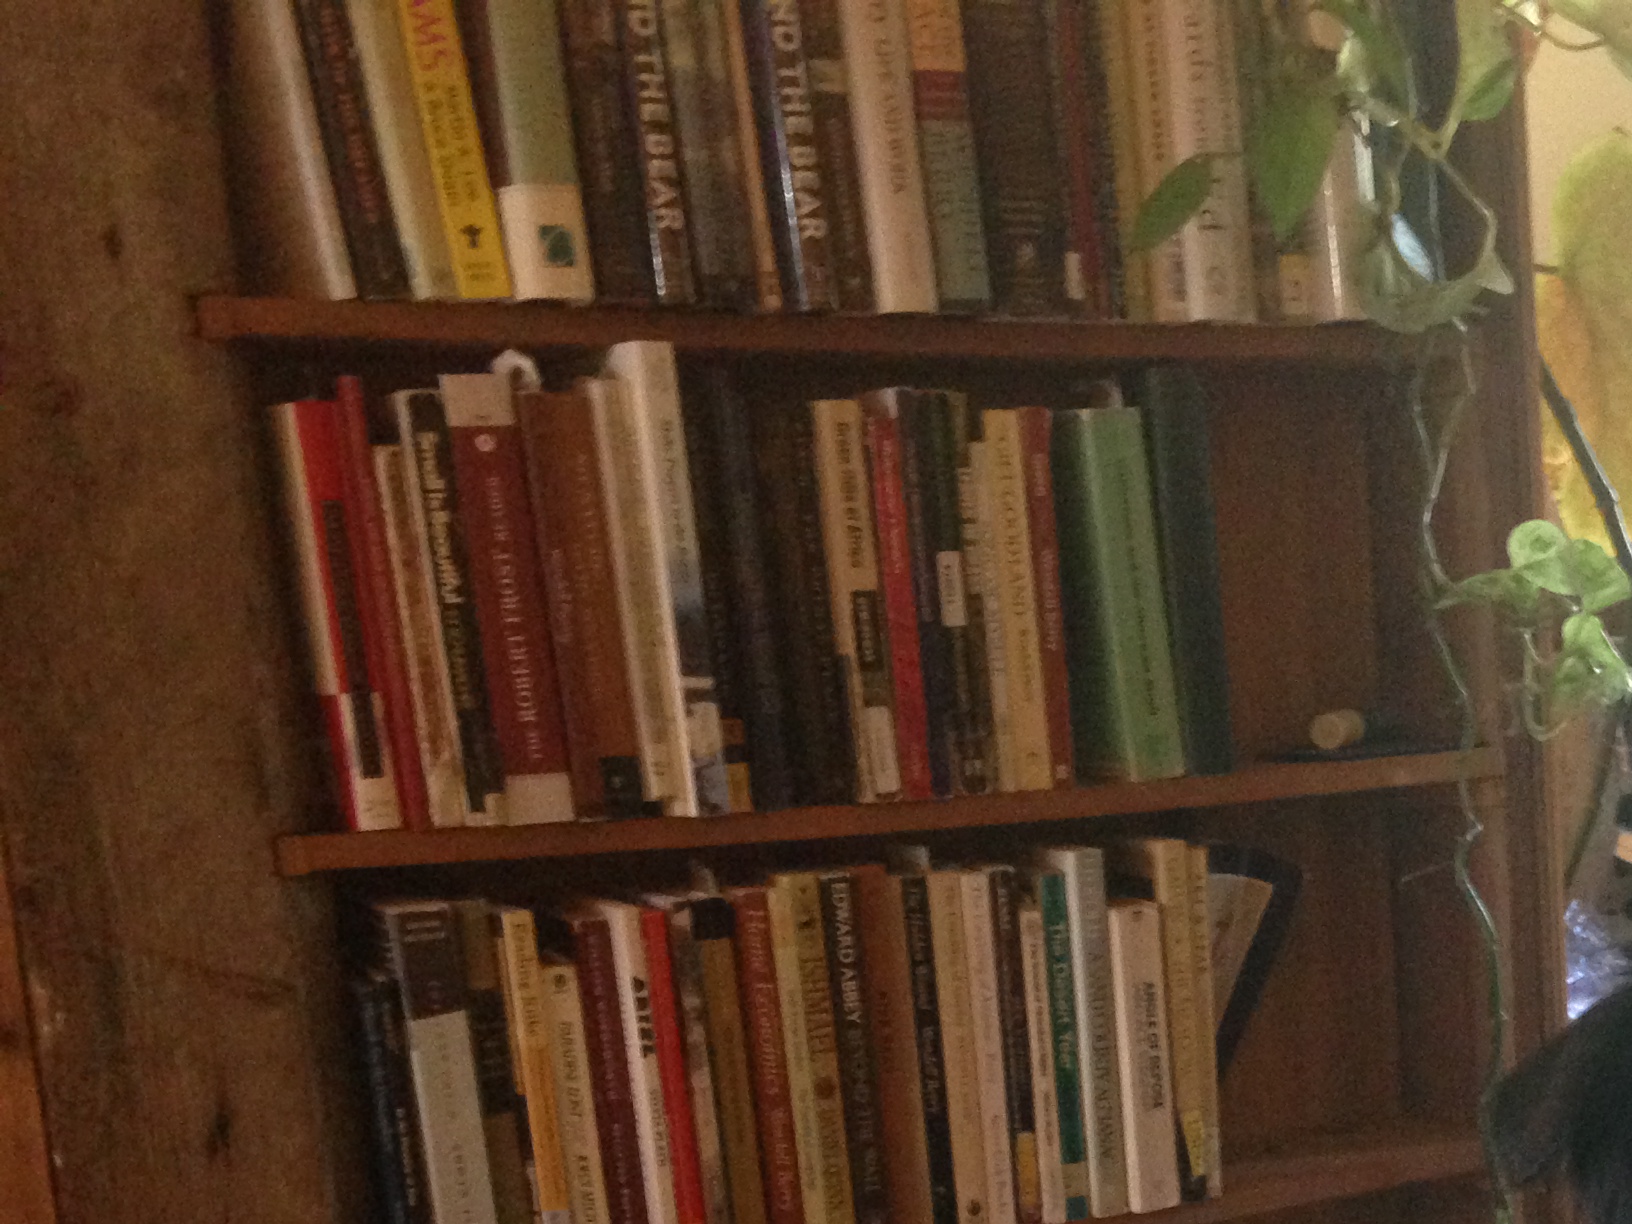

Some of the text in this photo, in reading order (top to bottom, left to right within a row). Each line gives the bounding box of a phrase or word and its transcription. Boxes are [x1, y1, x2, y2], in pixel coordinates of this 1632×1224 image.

[632, 50, 671, 125] THE
[776, 60, 813, 137] THE
[643, 129, 686, 233] BEAR
[787, 142, 827, 241] BEAR
[414, 428, 446, 491] Small
[426, 507, 466, 607] Beautiful
[845, 522, 869, 570] Africa
[489, 545, 524, 626] FROST
[502, 631, 539, 726] ROBERT
[744, 907, 771, 971] Home
[829, 881, 855, 964] EDWARD
[1048, 921, 1068, 957] The
[631, 974, 657, 1060] ARIEL
[798, 954, 836, 1064] ISHMAEL
[839, 965, 862, 1025] ABBEY
[1051, 961, 1073, 1027] Desert
[1142, 980, 1159, 1028] ANGLE
[751, 979, 787, 1097] Economics
[1148, 1054, 1166, 1109] REPOSE
[773, 1168, 797, 1212] Berry
